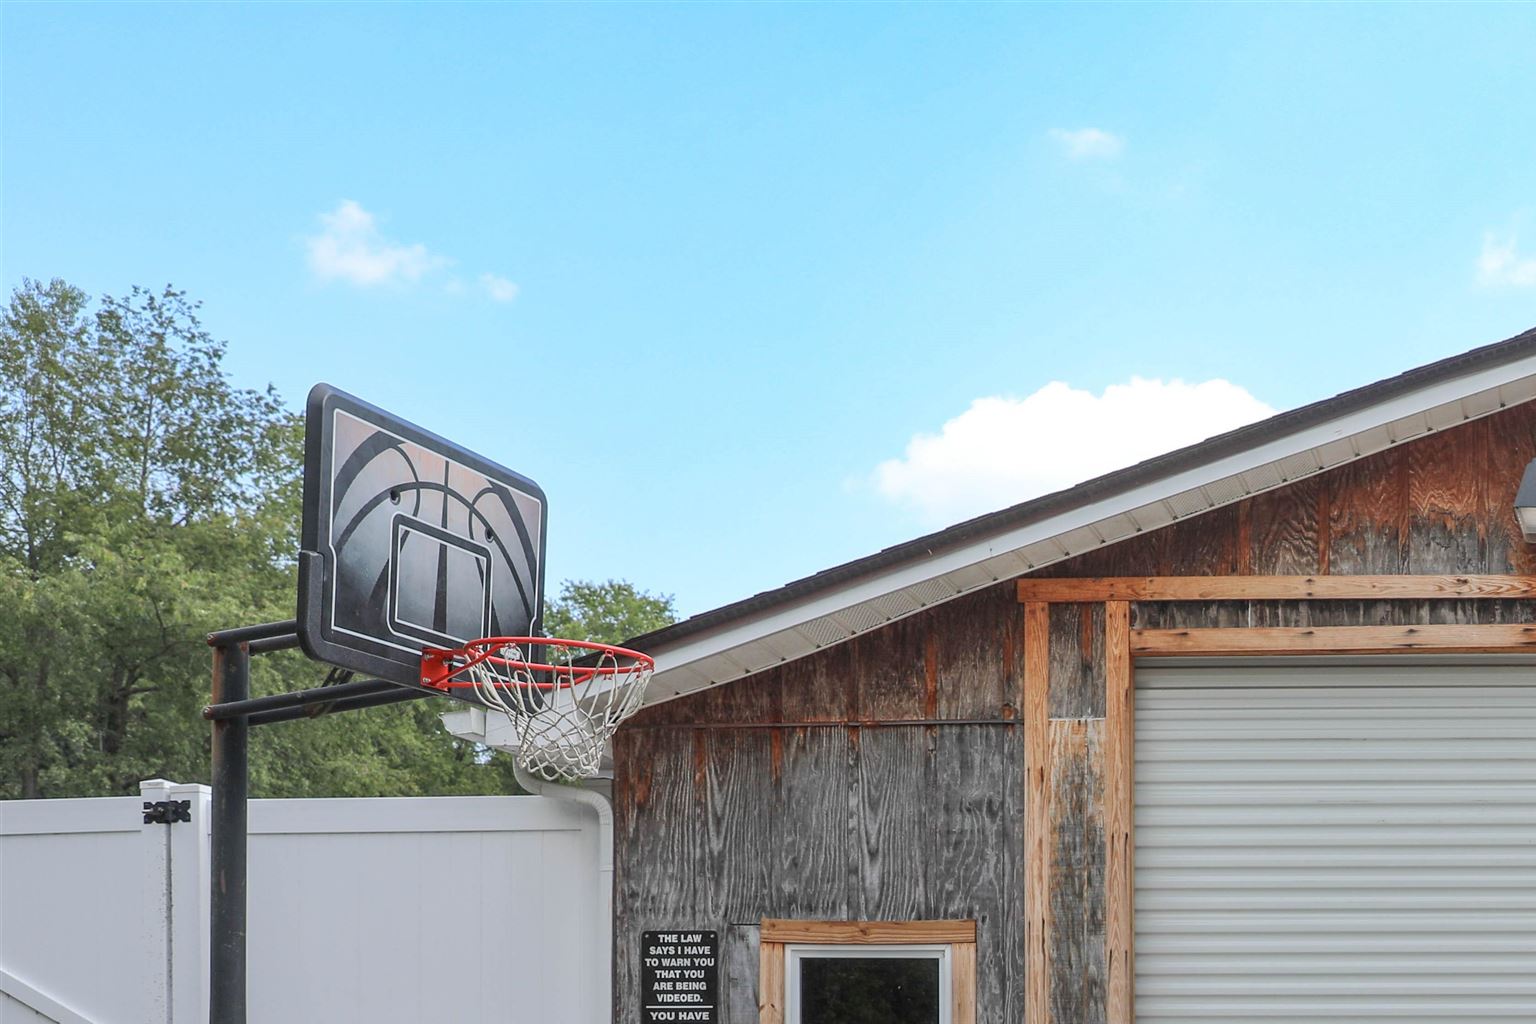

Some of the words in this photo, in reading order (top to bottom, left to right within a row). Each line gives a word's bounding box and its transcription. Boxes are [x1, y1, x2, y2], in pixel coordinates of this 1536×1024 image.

[658, 934, 678, 942] THE
[681, 934, 702, 942] LAW
[649, 946, 675, 954] SAYS
[645, 958, 658, 966] TO
[661, 958, 690, 966] WARN
[694, 958, 714, 966] YOU
[655, 970, 681, 978] THAT
[684, 970, 704, 978] YOU
[653, 982, 673, 990] ARE
[676, 982, 706, 990] BEING
[657, 994, 703, 1002] VIDEOED.
[650, 1012, 675, 1020] YOU
[679, 1012, 709, 1020] HAVE
